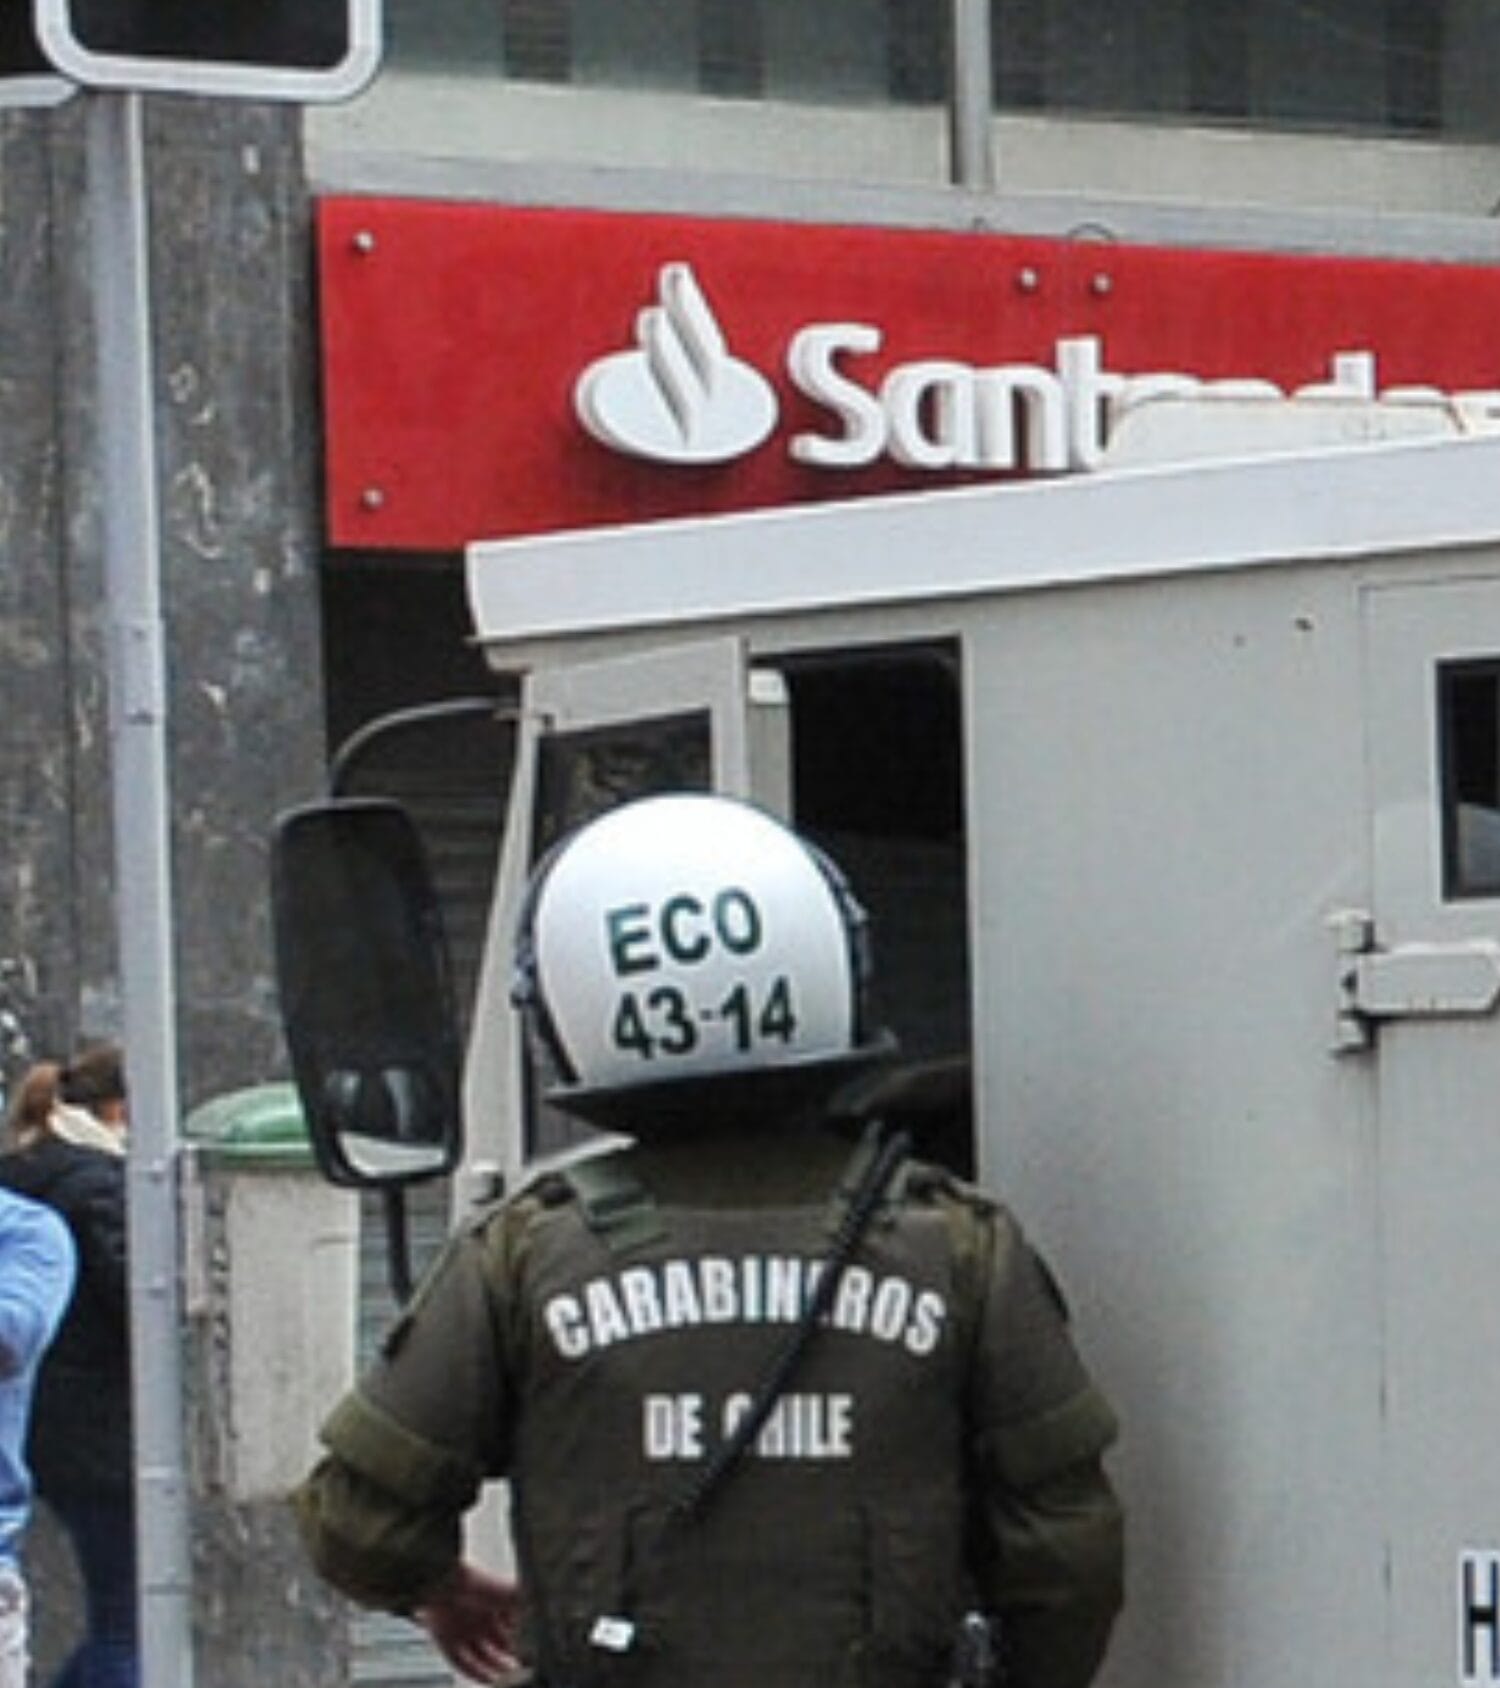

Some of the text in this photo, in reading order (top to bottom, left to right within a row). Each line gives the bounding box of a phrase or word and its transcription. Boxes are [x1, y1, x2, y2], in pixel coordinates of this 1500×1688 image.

[606, 886, 763, 976] ECO
[612, 975, 797, 1060] 43-14
[543, 1254, 947, 1358] CARABINROS
[643, 1393, 706, 1459] DE
